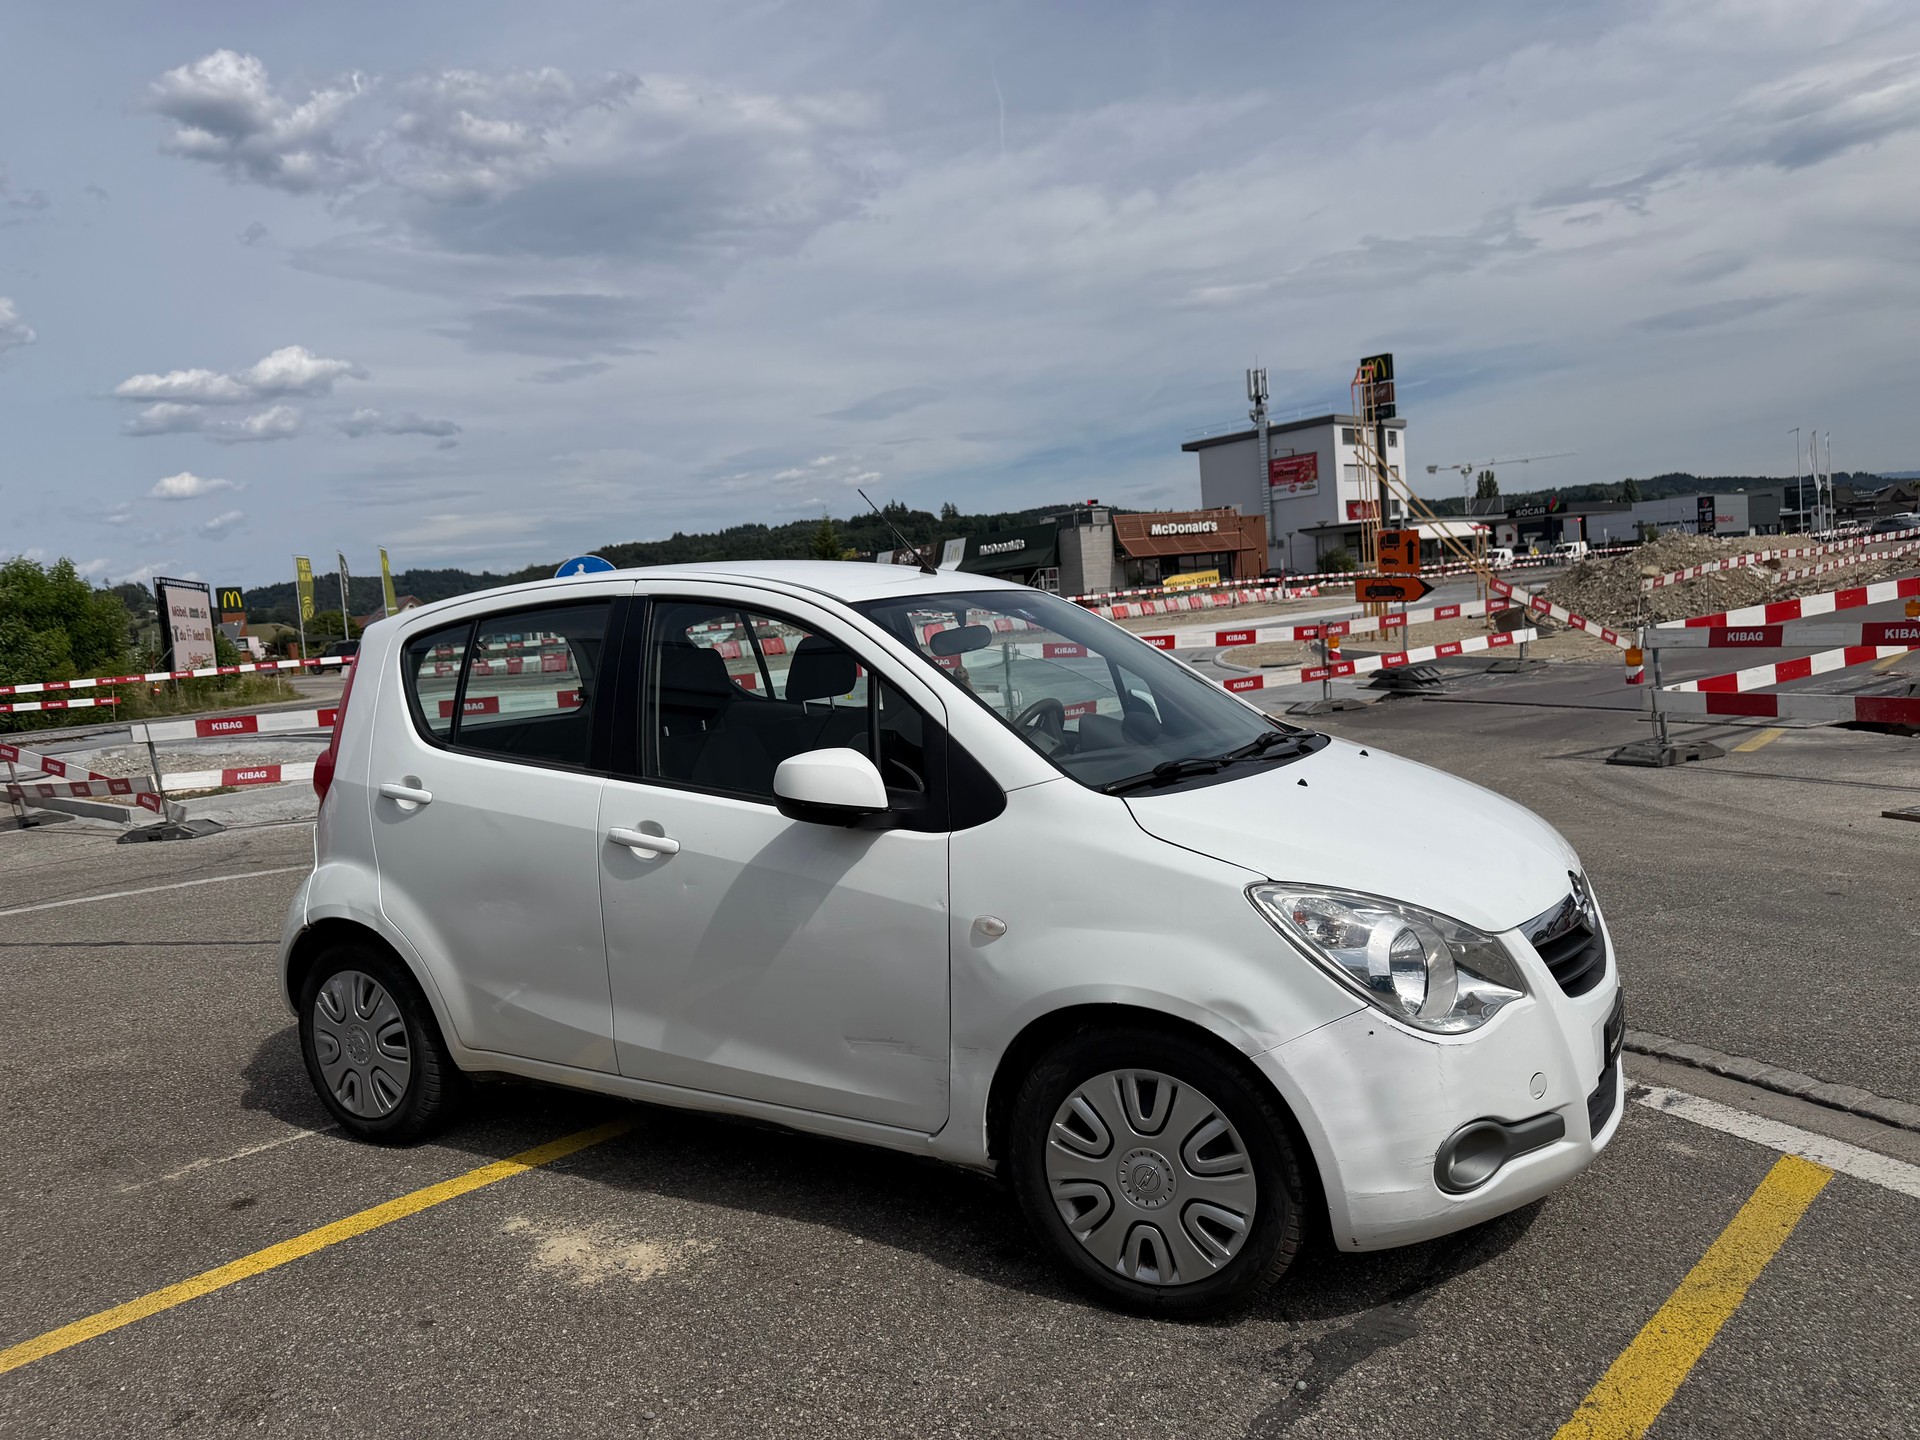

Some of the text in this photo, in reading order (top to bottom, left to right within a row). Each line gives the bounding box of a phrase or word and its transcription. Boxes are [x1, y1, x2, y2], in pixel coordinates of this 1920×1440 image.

[1516, 507, 1545, 517] SOCAR
[1151, 521, 1218, 535] McDonald's
[1440, 608, 1455, 616] KIBAG
[1385, 617, 1401, 625] KIBAG
[1303, 628, 1318, 636] KIB
[1726, 631, 1764, 642] KIBAG
[1226, 634, 1247, 642] KIBAG
[1492, 635, 1508, 643] KIBAG
[1054, 647, 1077, 655] KIBAG
[1441, 646, 1456, 654] KIBAG
[1387, 655, 1402, 664] KIBAG
[1233, 680, 1254, 689] KIBAG
[464, 702, 485, 711] BAG
[212, 720, 243, 731] KIBAG
[47, 762, 61, 773] KIBAG
[237, 770, 267, 780] KIBAG
